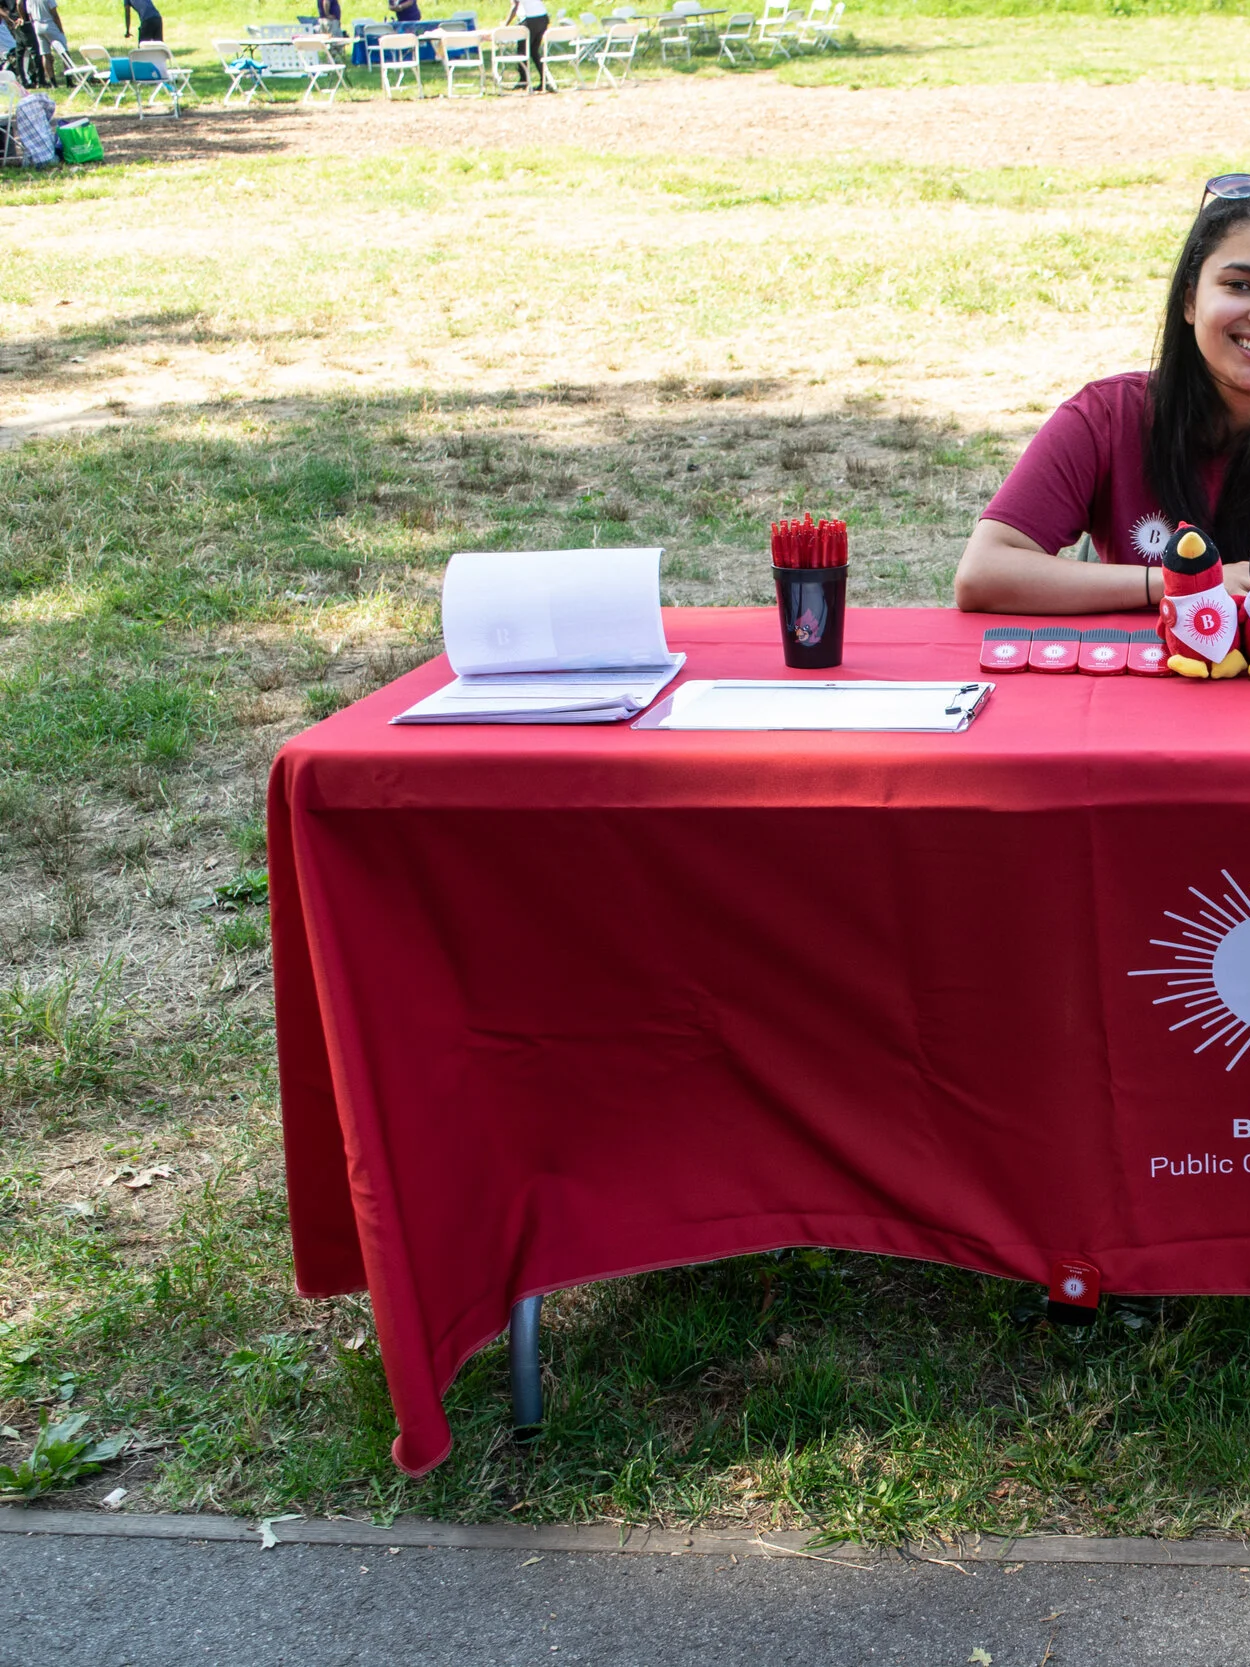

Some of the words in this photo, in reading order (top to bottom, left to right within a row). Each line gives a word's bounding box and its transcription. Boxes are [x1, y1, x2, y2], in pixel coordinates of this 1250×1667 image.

[1149, 529, 1161, 544] B
[1200, 613, 1215, 630] B
[1150, 1153, 1234, 1178] Public
